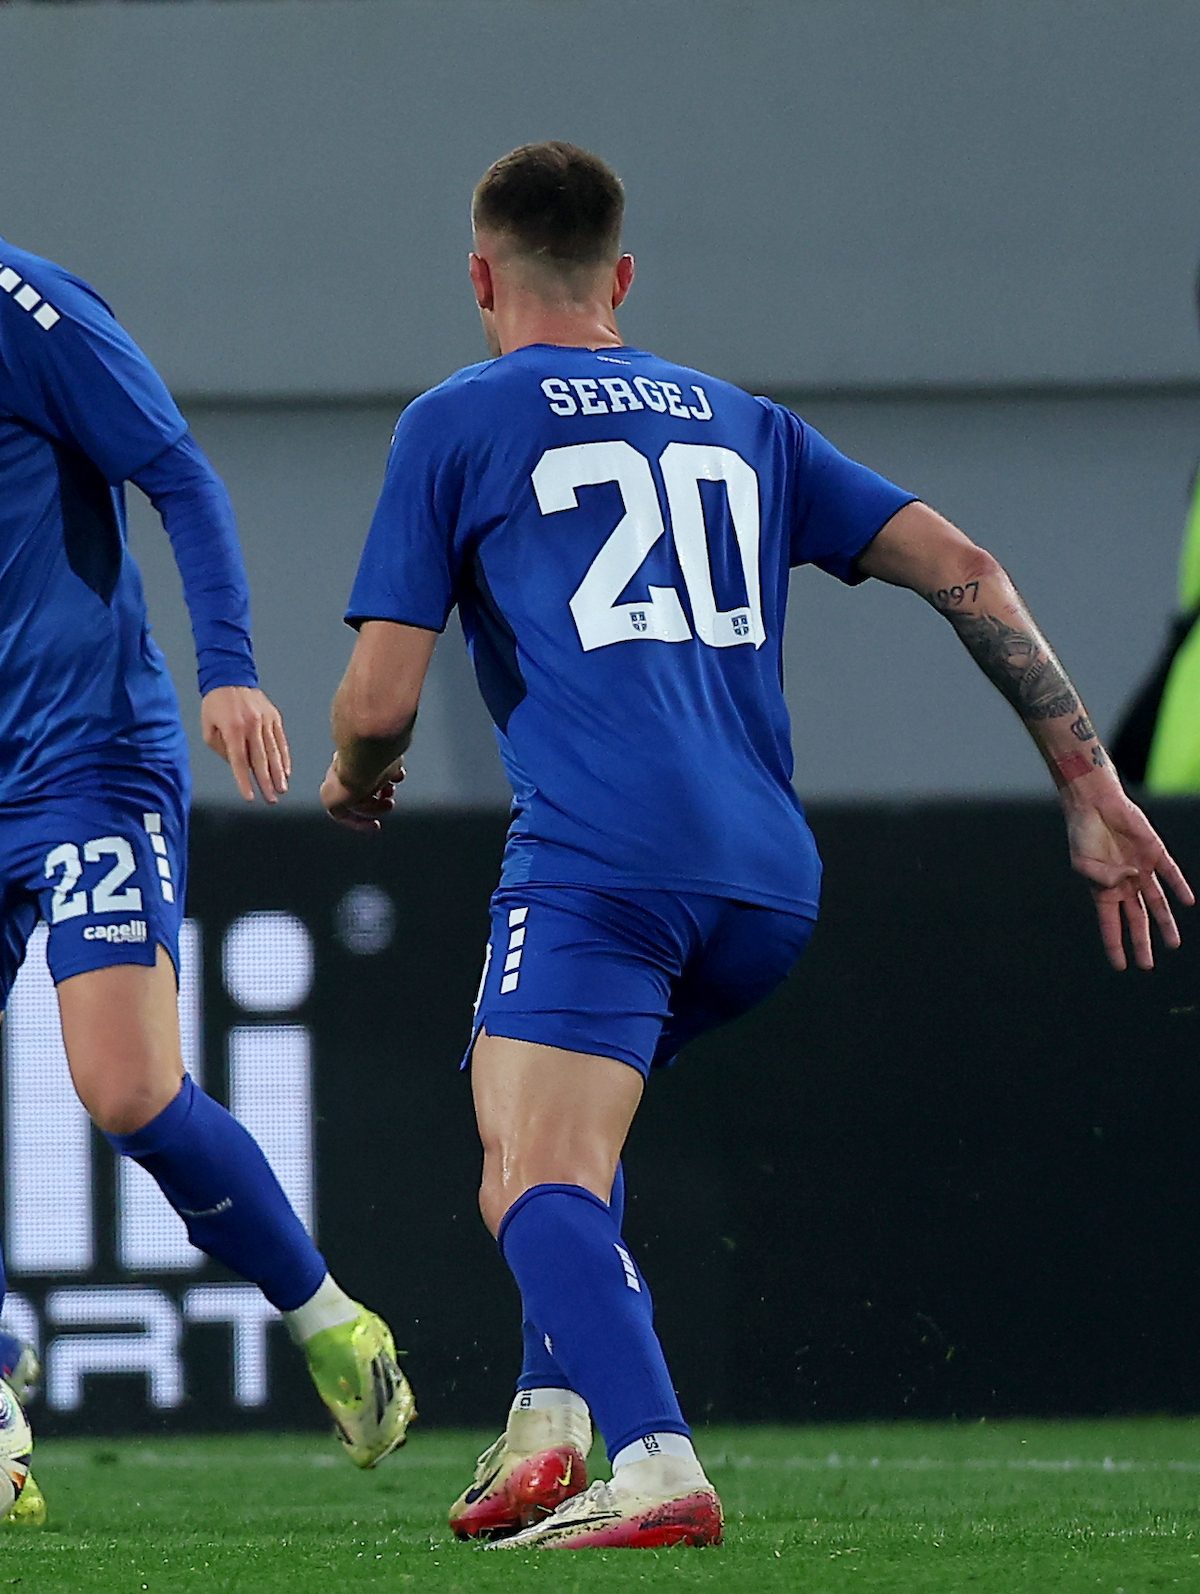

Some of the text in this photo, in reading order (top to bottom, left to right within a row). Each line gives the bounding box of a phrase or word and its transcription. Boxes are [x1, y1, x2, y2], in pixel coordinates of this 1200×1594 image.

[540, 376, 713, 420] SERGEJ
[531, 440, 766, 651] 20
[44, 835, 143, 924] 22
[83, 919, 147, 943] capelli
